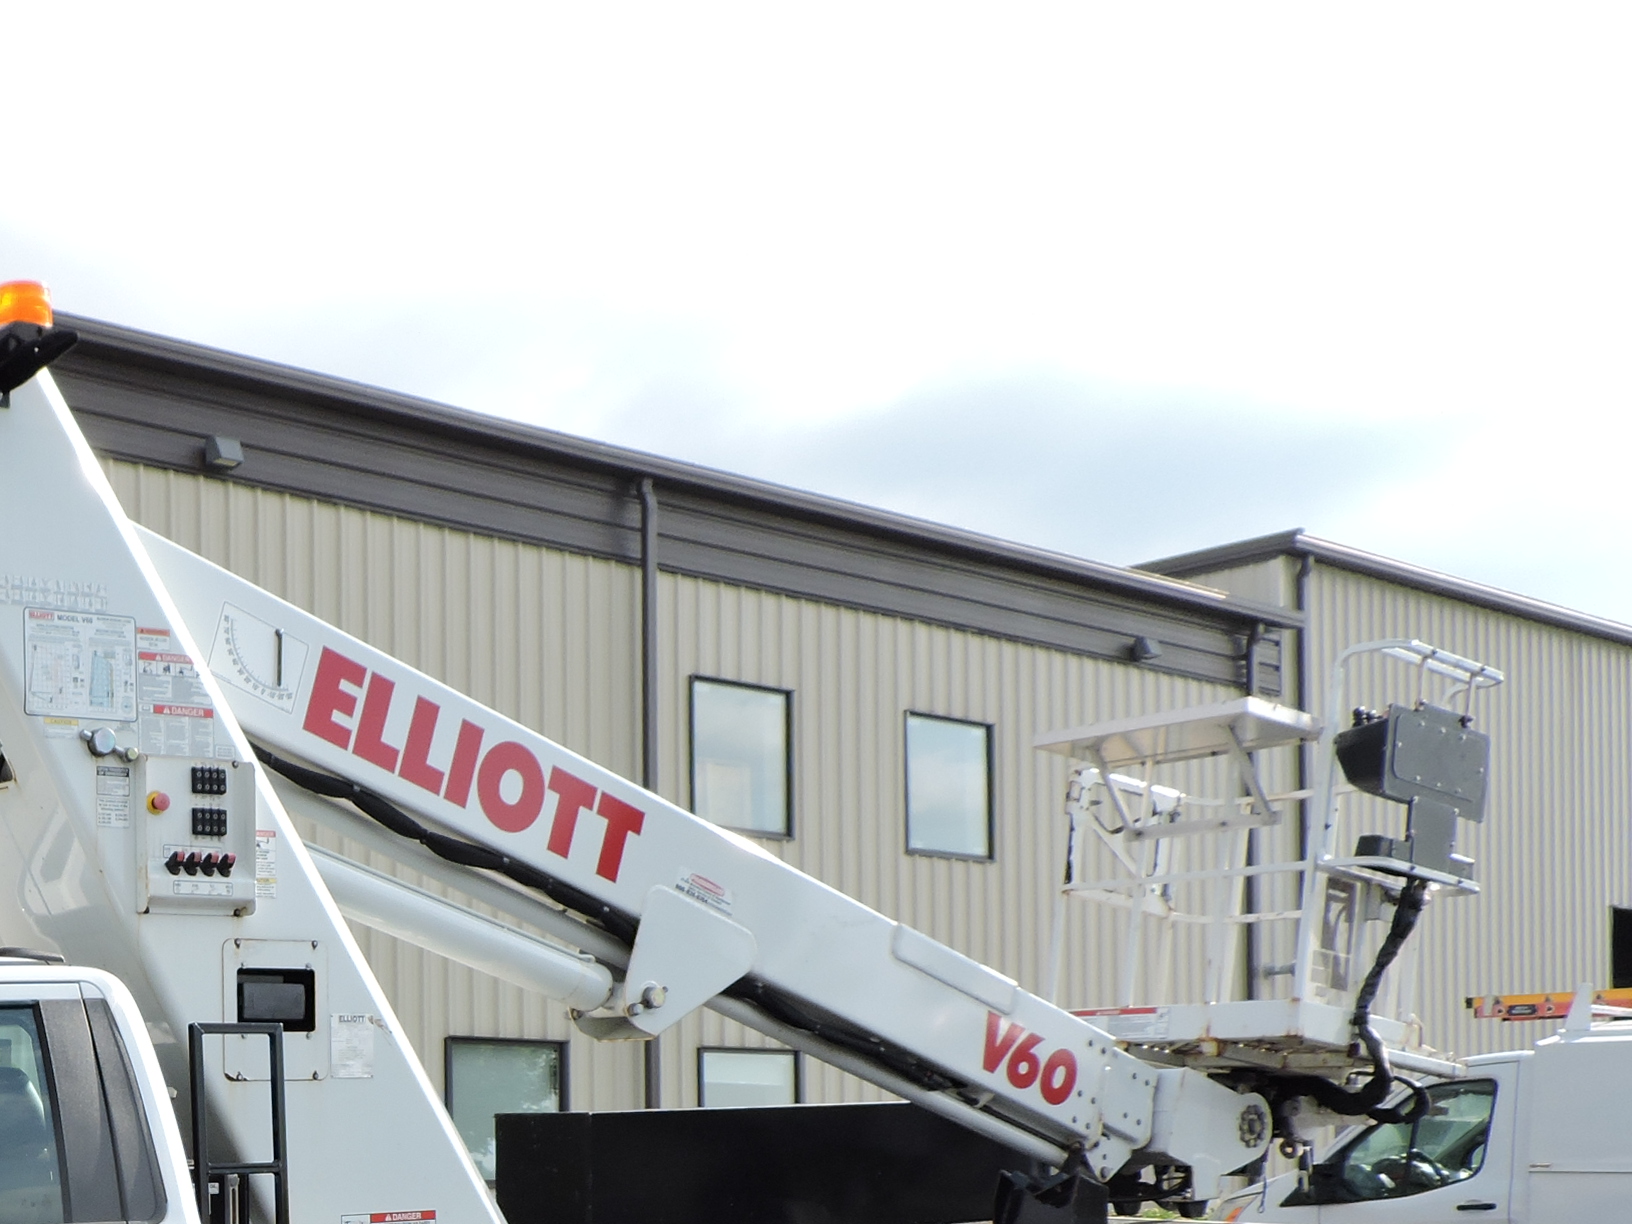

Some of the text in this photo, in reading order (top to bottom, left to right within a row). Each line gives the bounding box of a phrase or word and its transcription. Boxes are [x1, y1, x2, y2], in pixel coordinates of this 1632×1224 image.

[171, 707, 204, 717] DANGER
[303, 645, 645, 884] ELLIOTT
[338, 1014, 366, 1023] ELLIOTT
[982, 1009, 1078, 1106] V60
[392, 1212, 422, 1221] DANGER
